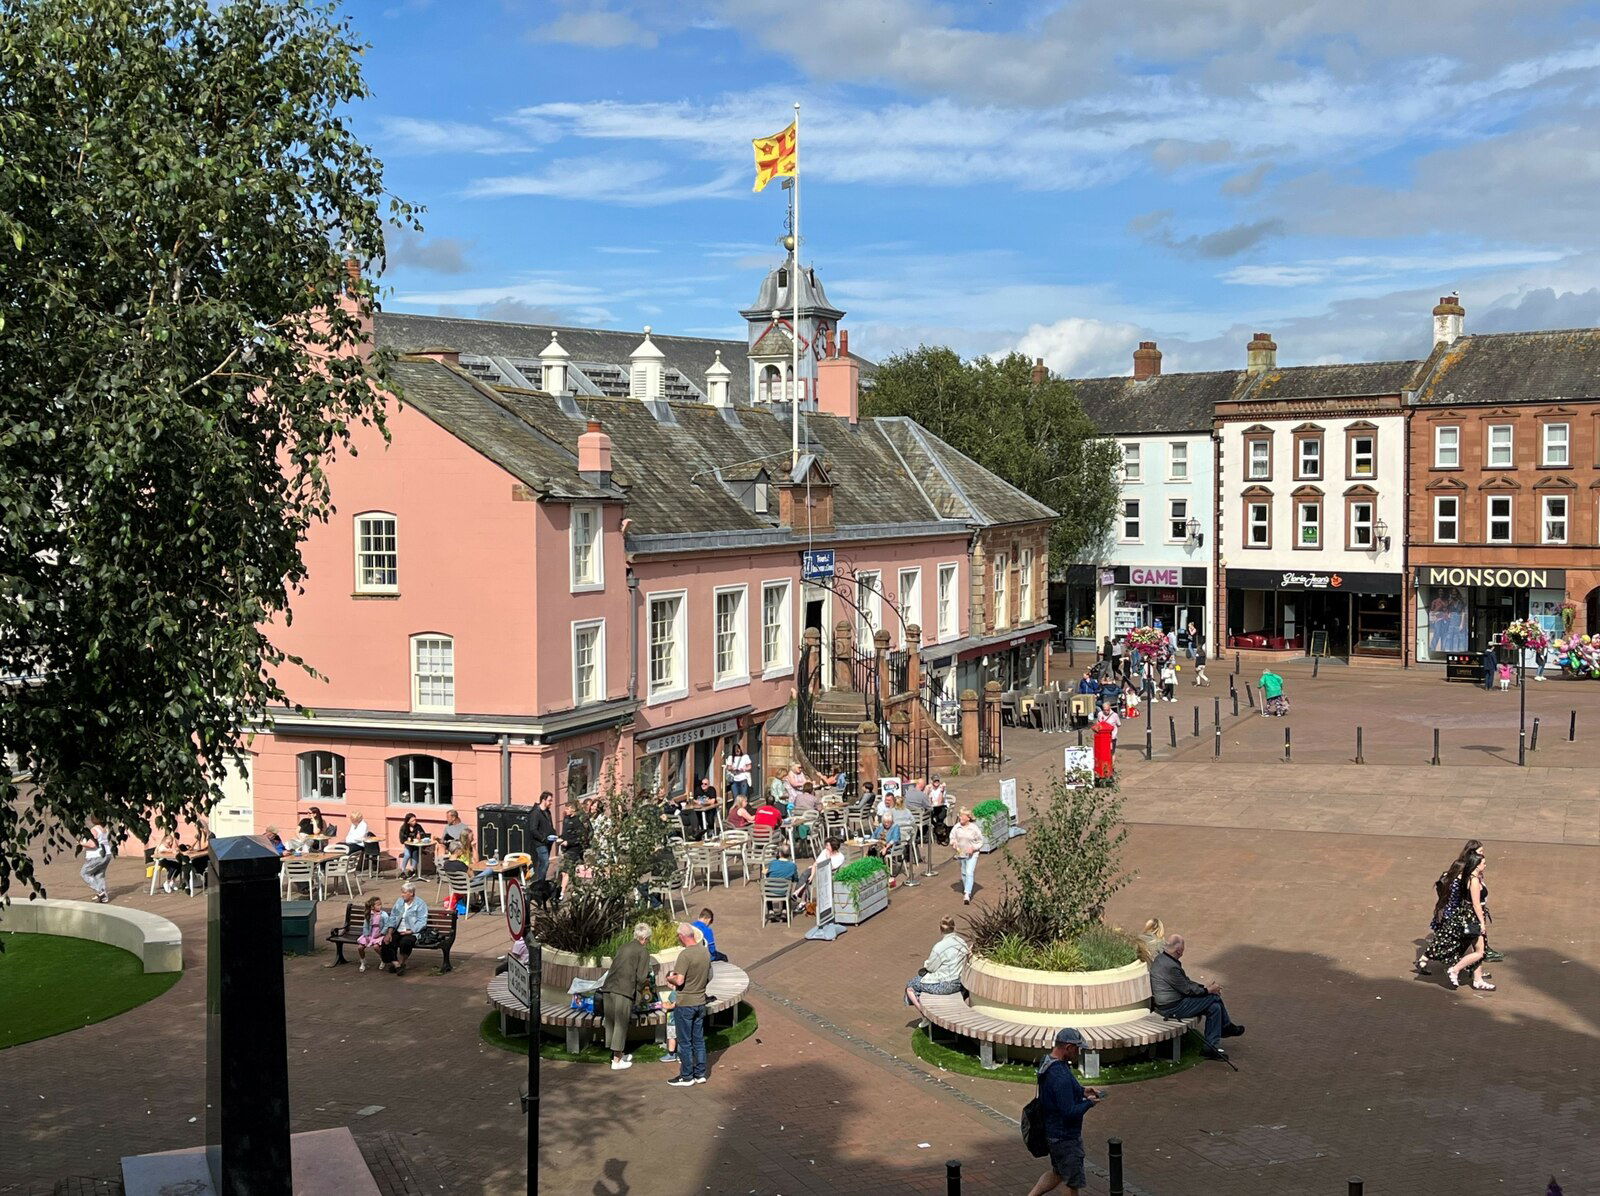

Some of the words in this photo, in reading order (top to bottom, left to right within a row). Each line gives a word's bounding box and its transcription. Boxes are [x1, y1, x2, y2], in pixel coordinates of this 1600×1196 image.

[1131, 568, 1178, 585] GAME
[1430, 568, 1547, 588] MONSOON
[711, 723, 727, 735] HUB
